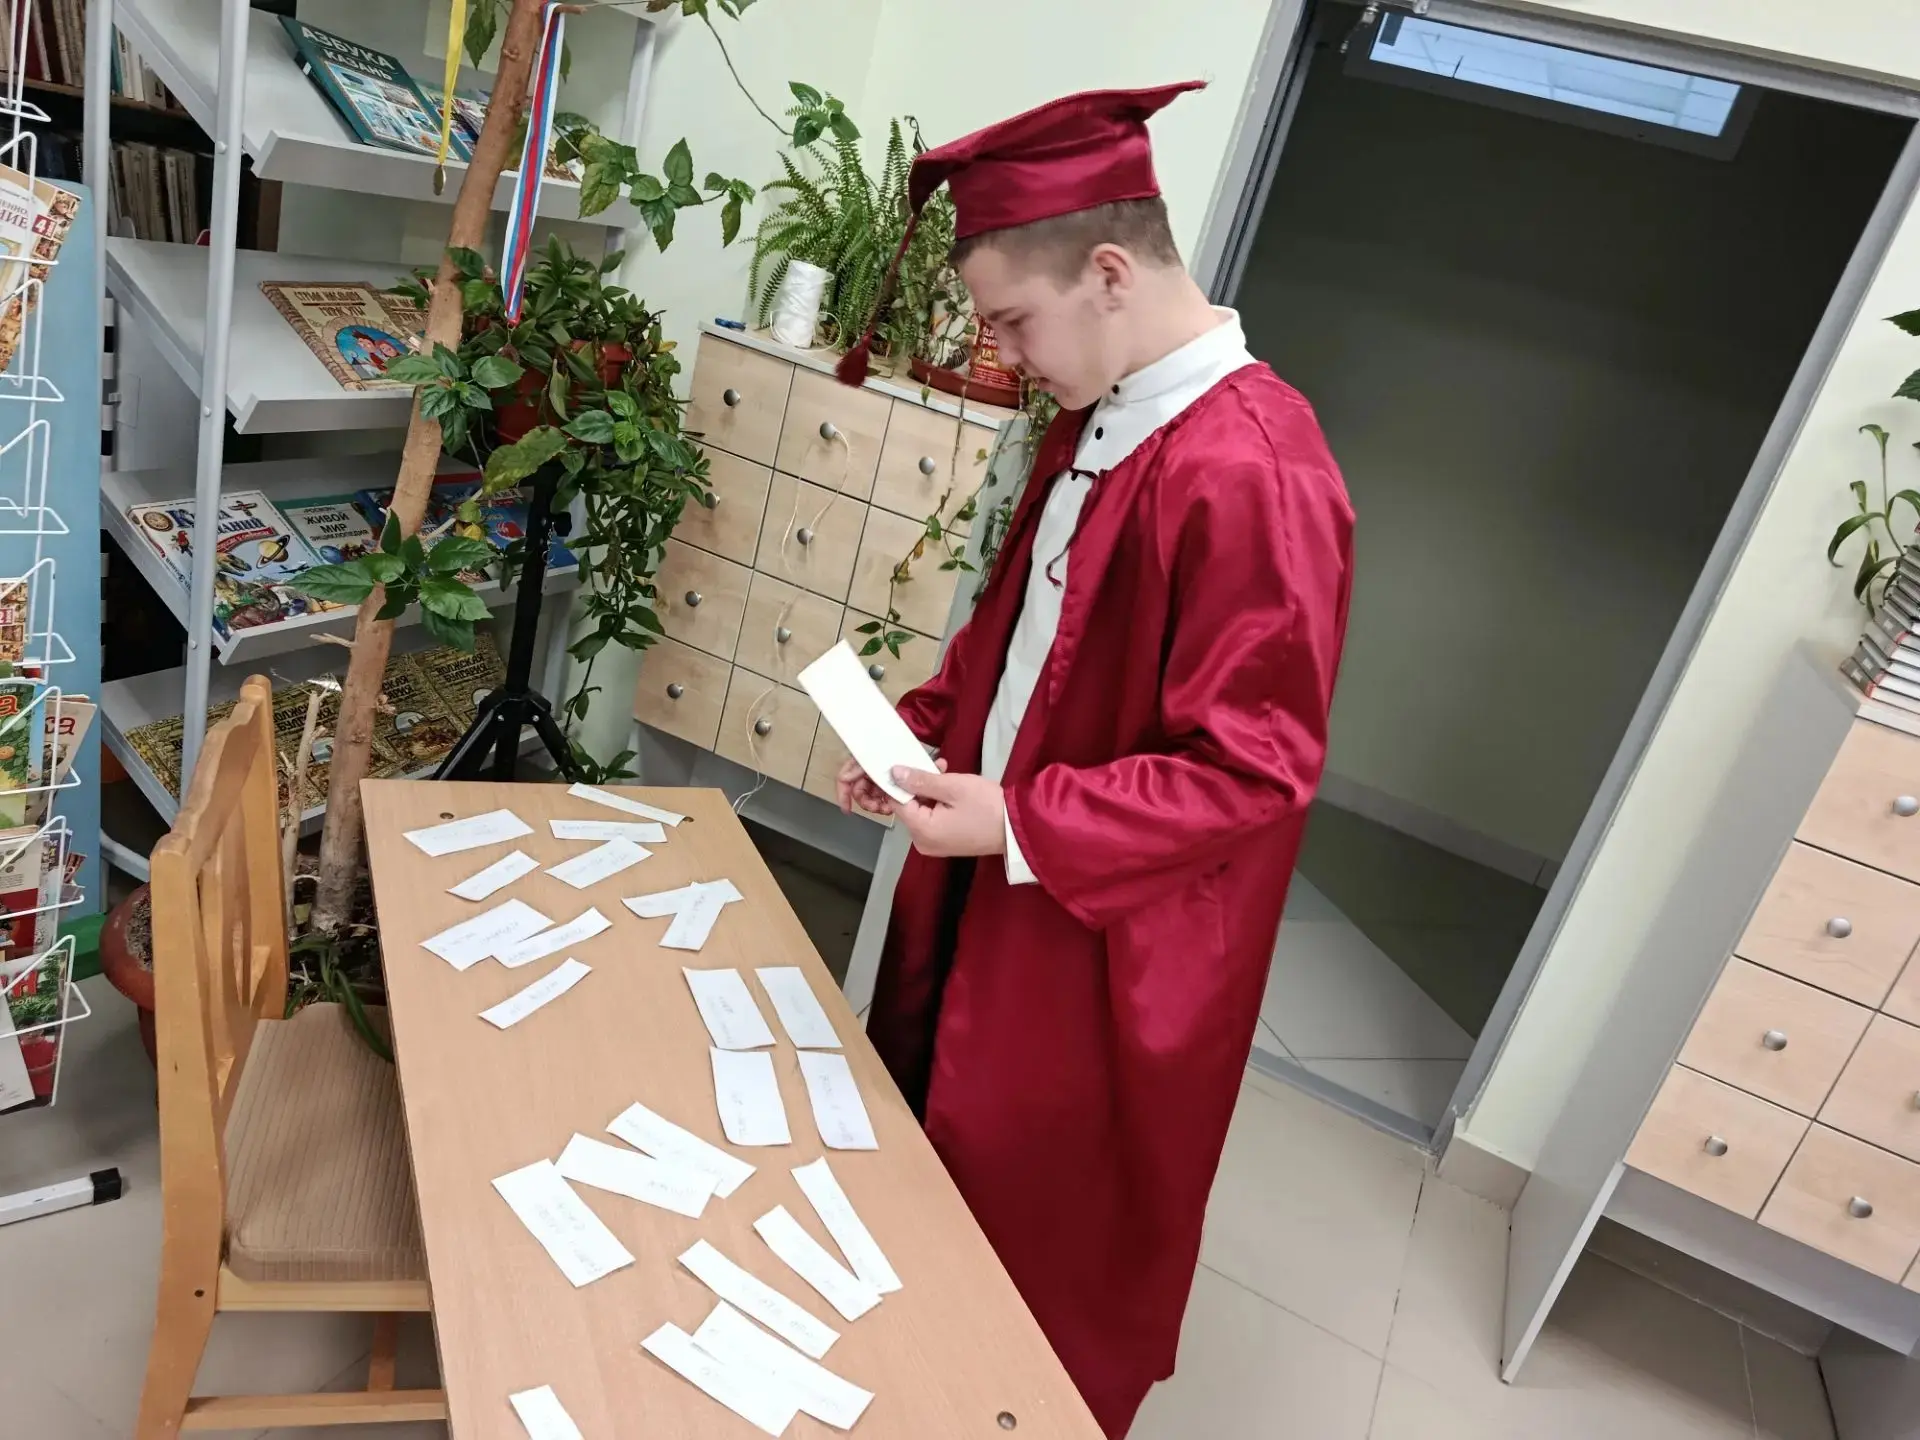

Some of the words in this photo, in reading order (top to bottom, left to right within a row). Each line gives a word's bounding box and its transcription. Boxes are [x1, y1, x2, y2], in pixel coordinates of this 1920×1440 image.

[301, 26, 395, 70] АЗБУКА
[323, 49, 392, 80] КАЗАНЬ
[304, 512, 350, 525] ЖИВОЙ
[320, 523, 347, 533] МИР
[436, 653, 485, 675] ВОЛЖСКАЯ
[445, 662, 489, 682] БУЛГАРИЯ
